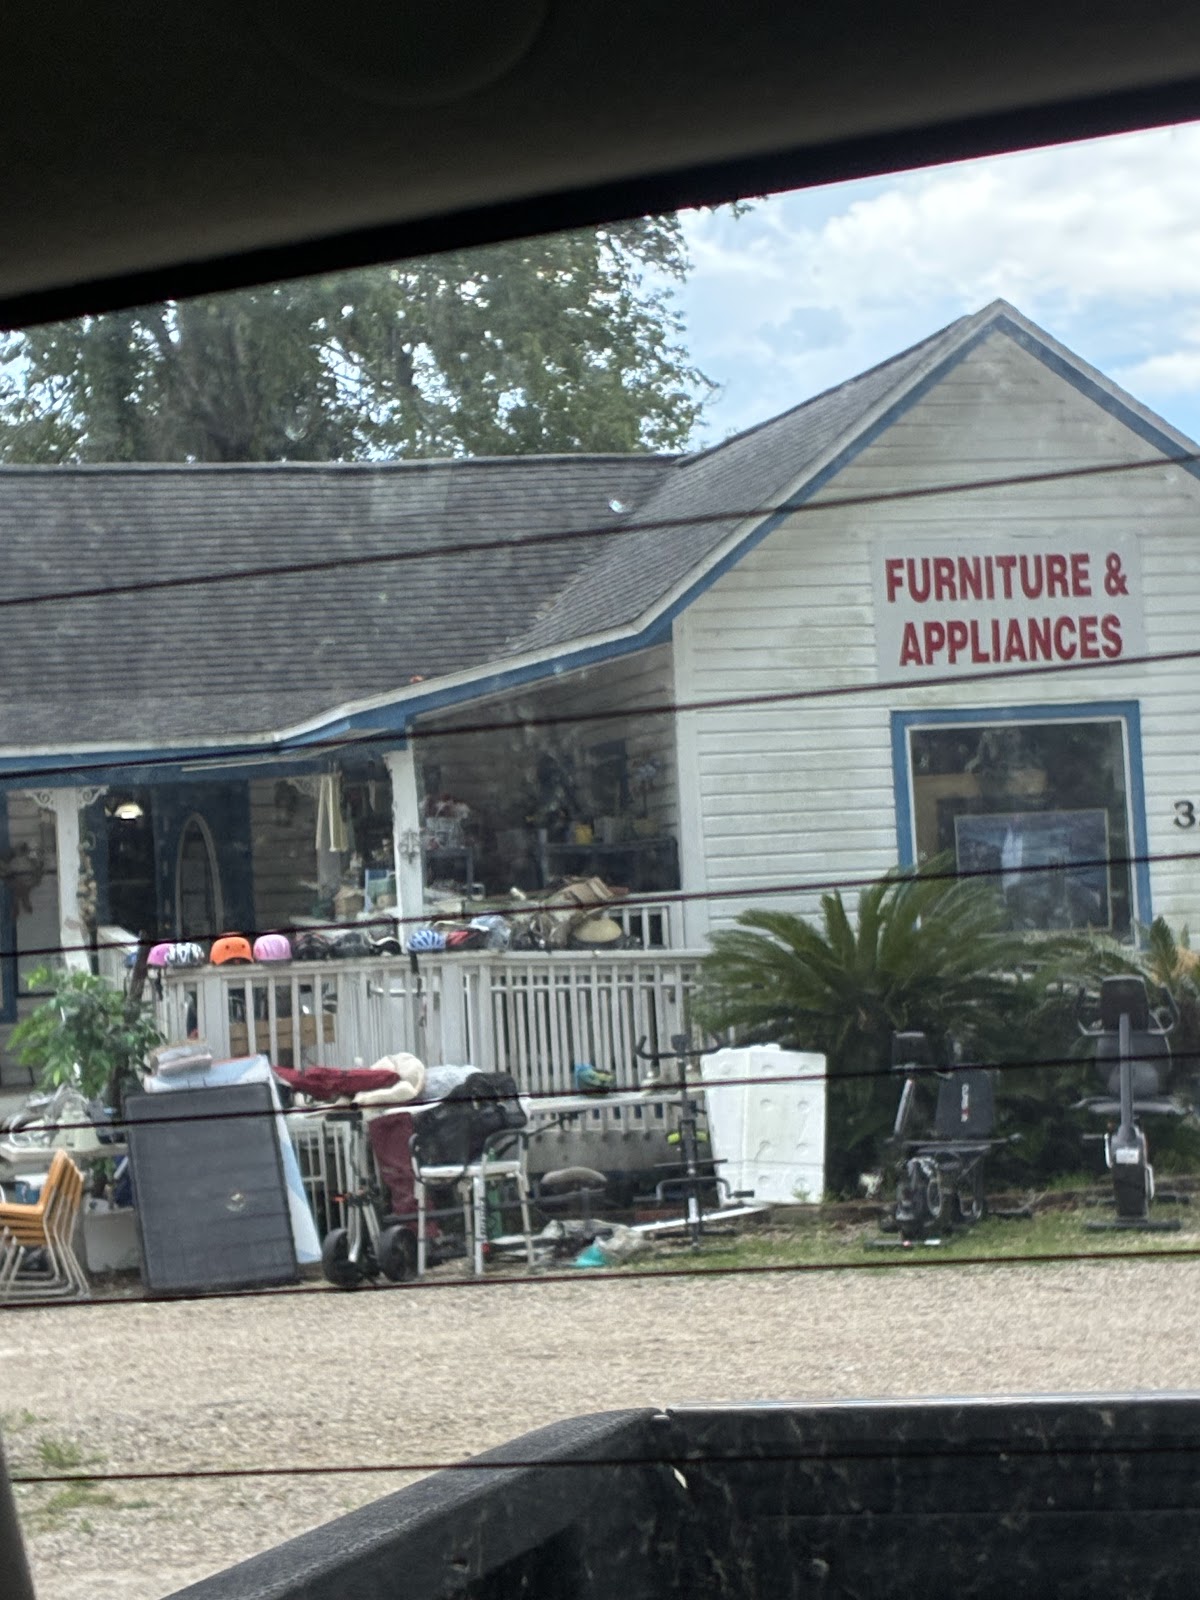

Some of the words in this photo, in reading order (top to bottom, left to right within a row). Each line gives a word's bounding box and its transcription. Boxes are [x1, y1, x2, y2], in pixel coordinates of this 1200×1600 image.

[885, 553, 1092, 603] FURNITURE
[1103, 551, 1129, 597] &
[899, 614, 1123, 667] APPLIANCES
